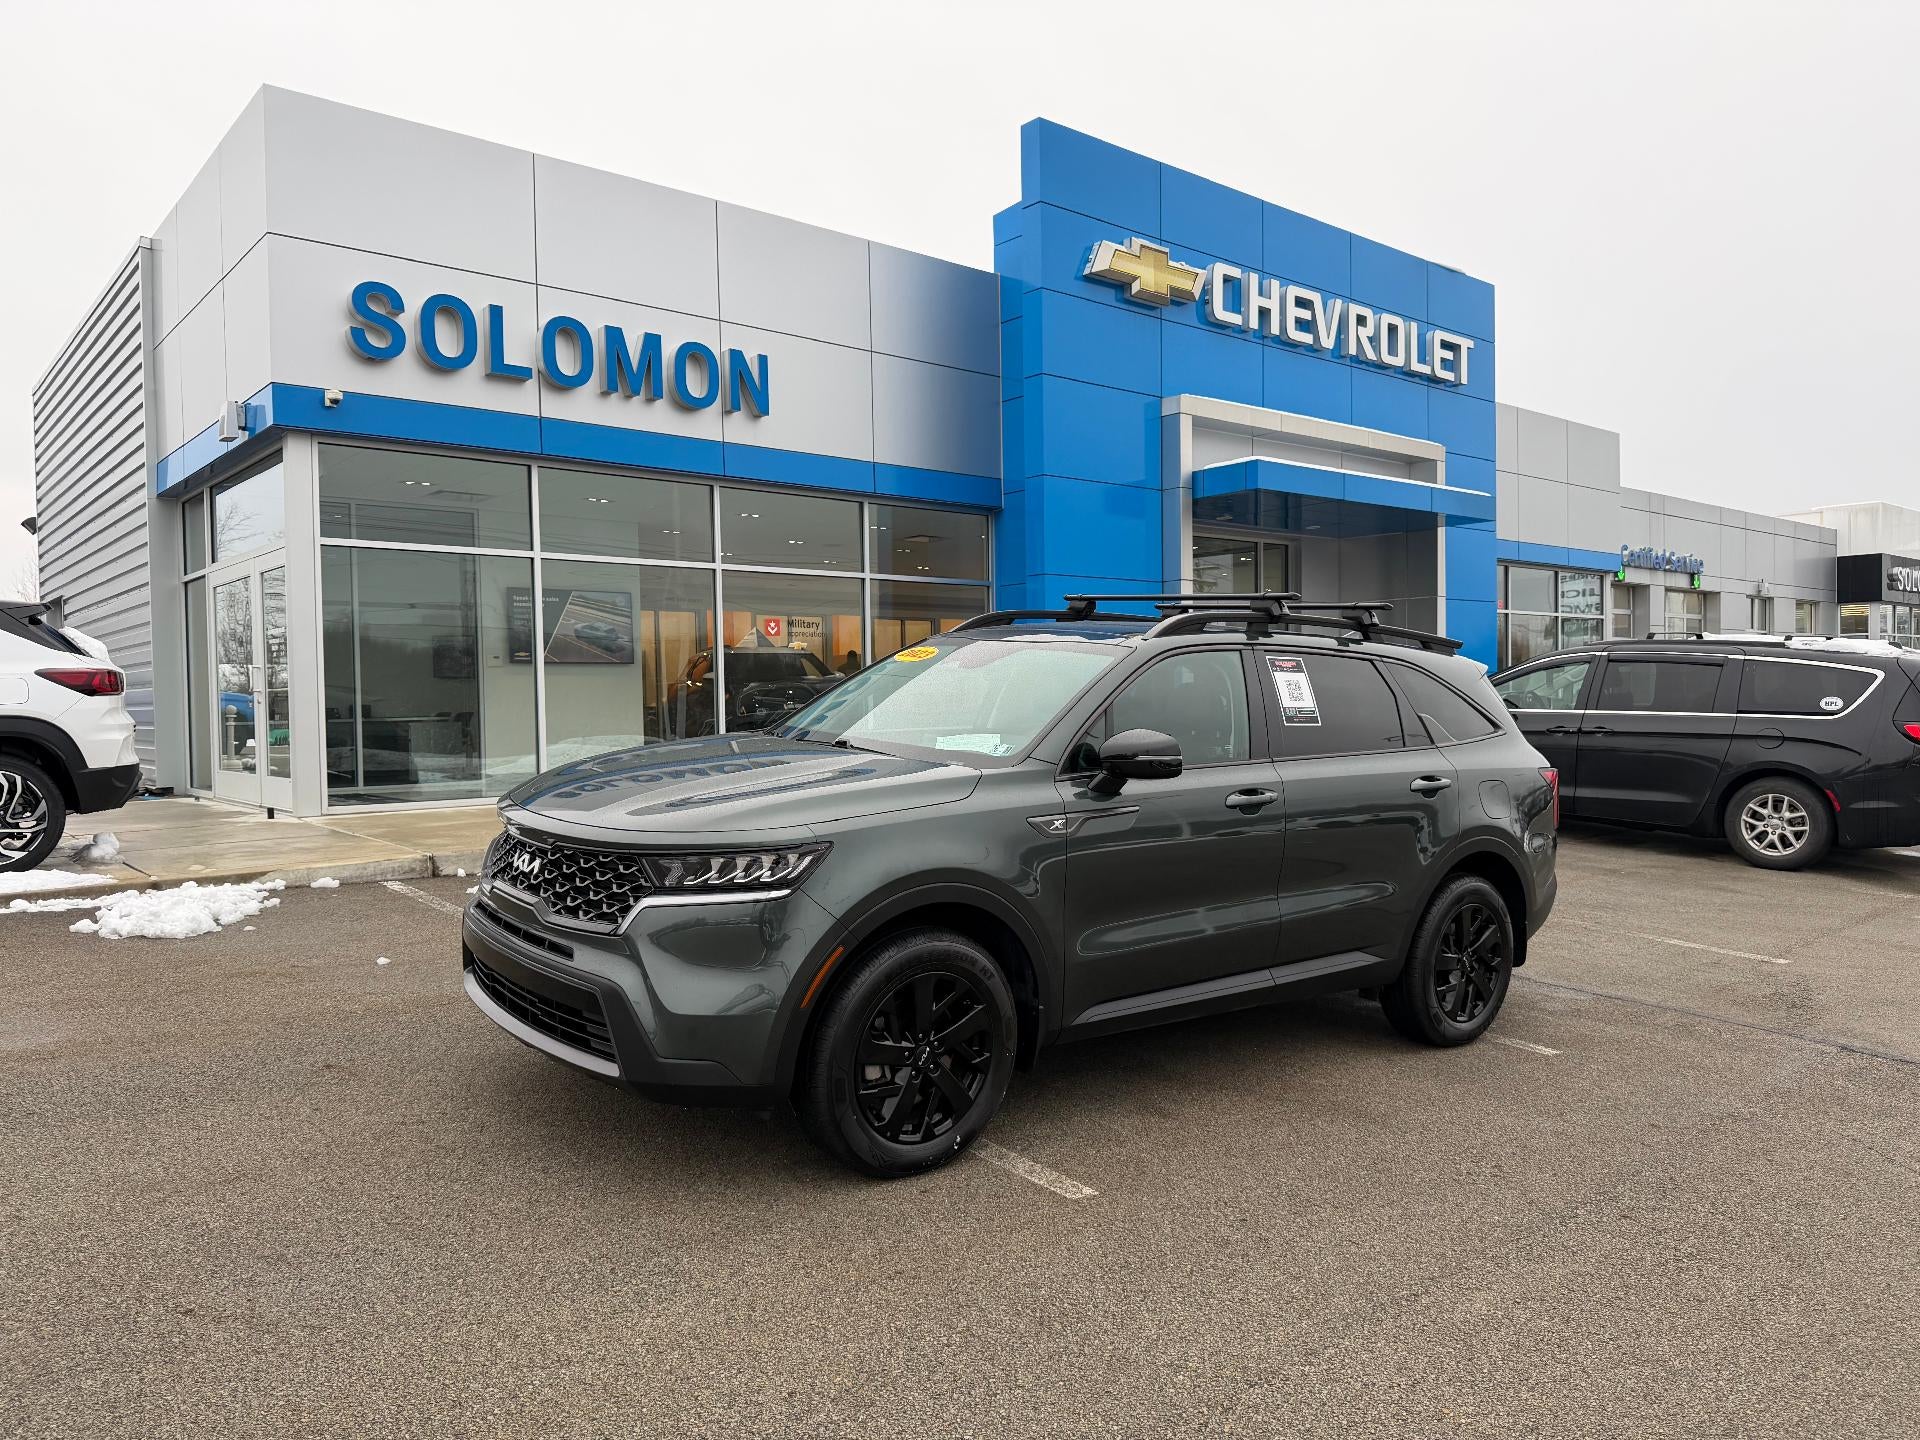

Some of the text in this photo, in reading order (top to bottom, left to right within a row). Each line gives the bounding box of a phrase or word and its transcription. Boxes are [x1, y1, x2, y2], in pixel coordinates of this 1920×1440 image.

[347, 280, 770, 417] SOLOMON
[1207, 261, 1475, 386] CHEVROLET
[1621, 544, 1704, 575] Certified Service
[787, 618, 820, 630] Military
